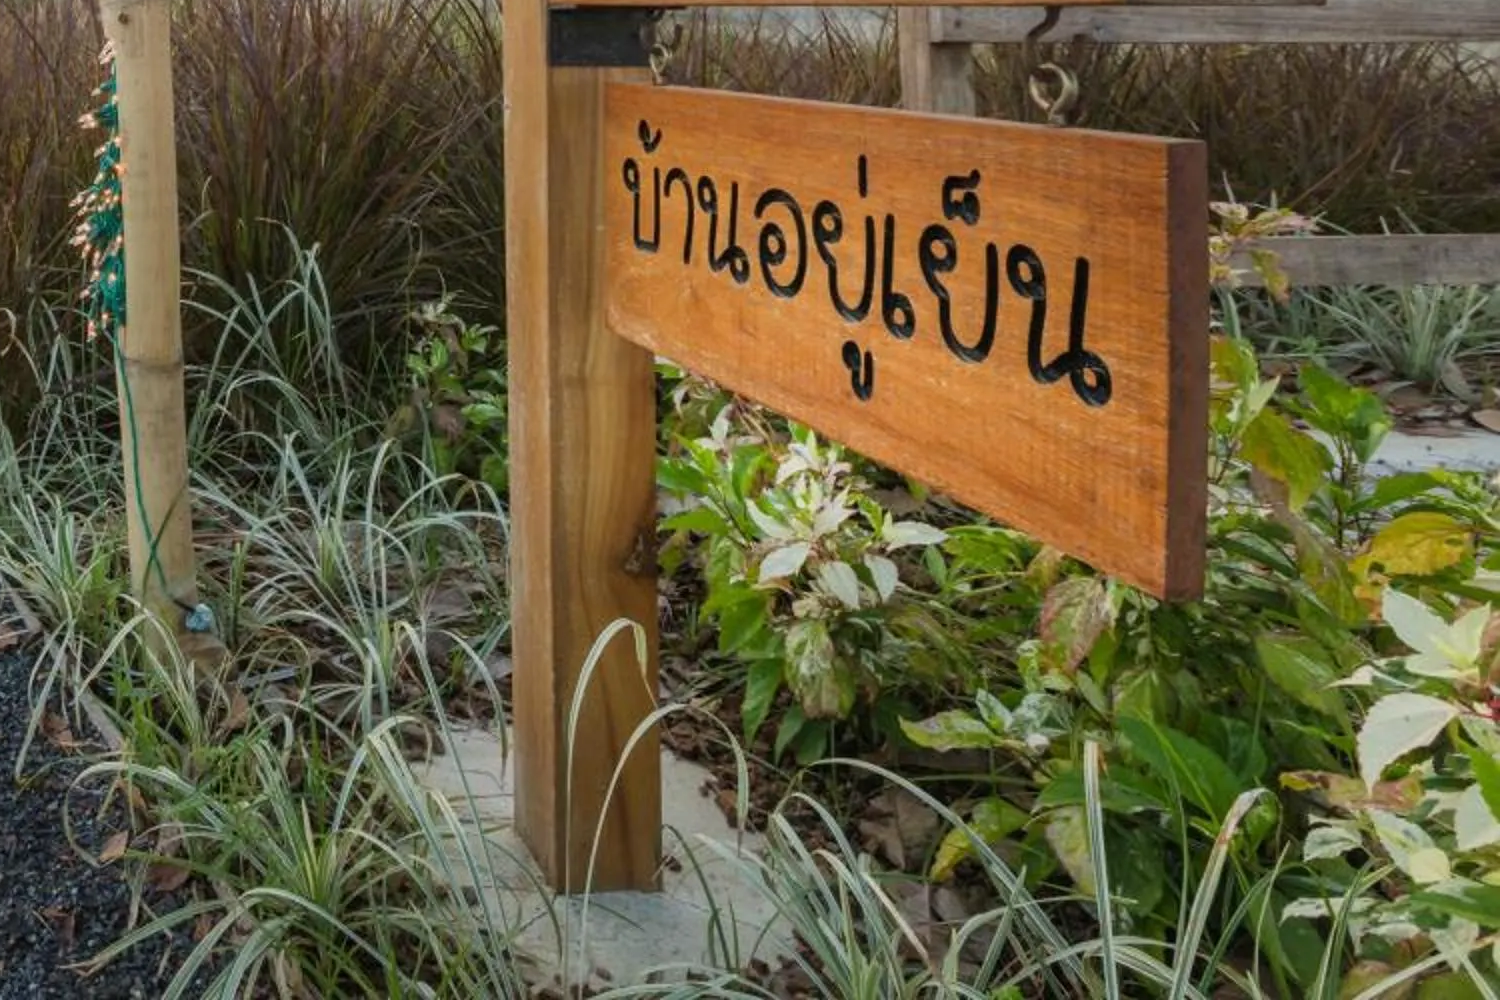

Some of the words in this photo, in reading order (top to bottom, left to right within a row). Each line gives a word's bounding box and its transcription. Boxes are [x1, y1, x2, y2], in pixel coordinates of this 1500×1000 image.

[622, 118, 1113, 406] บ้านอยู่เย็น
